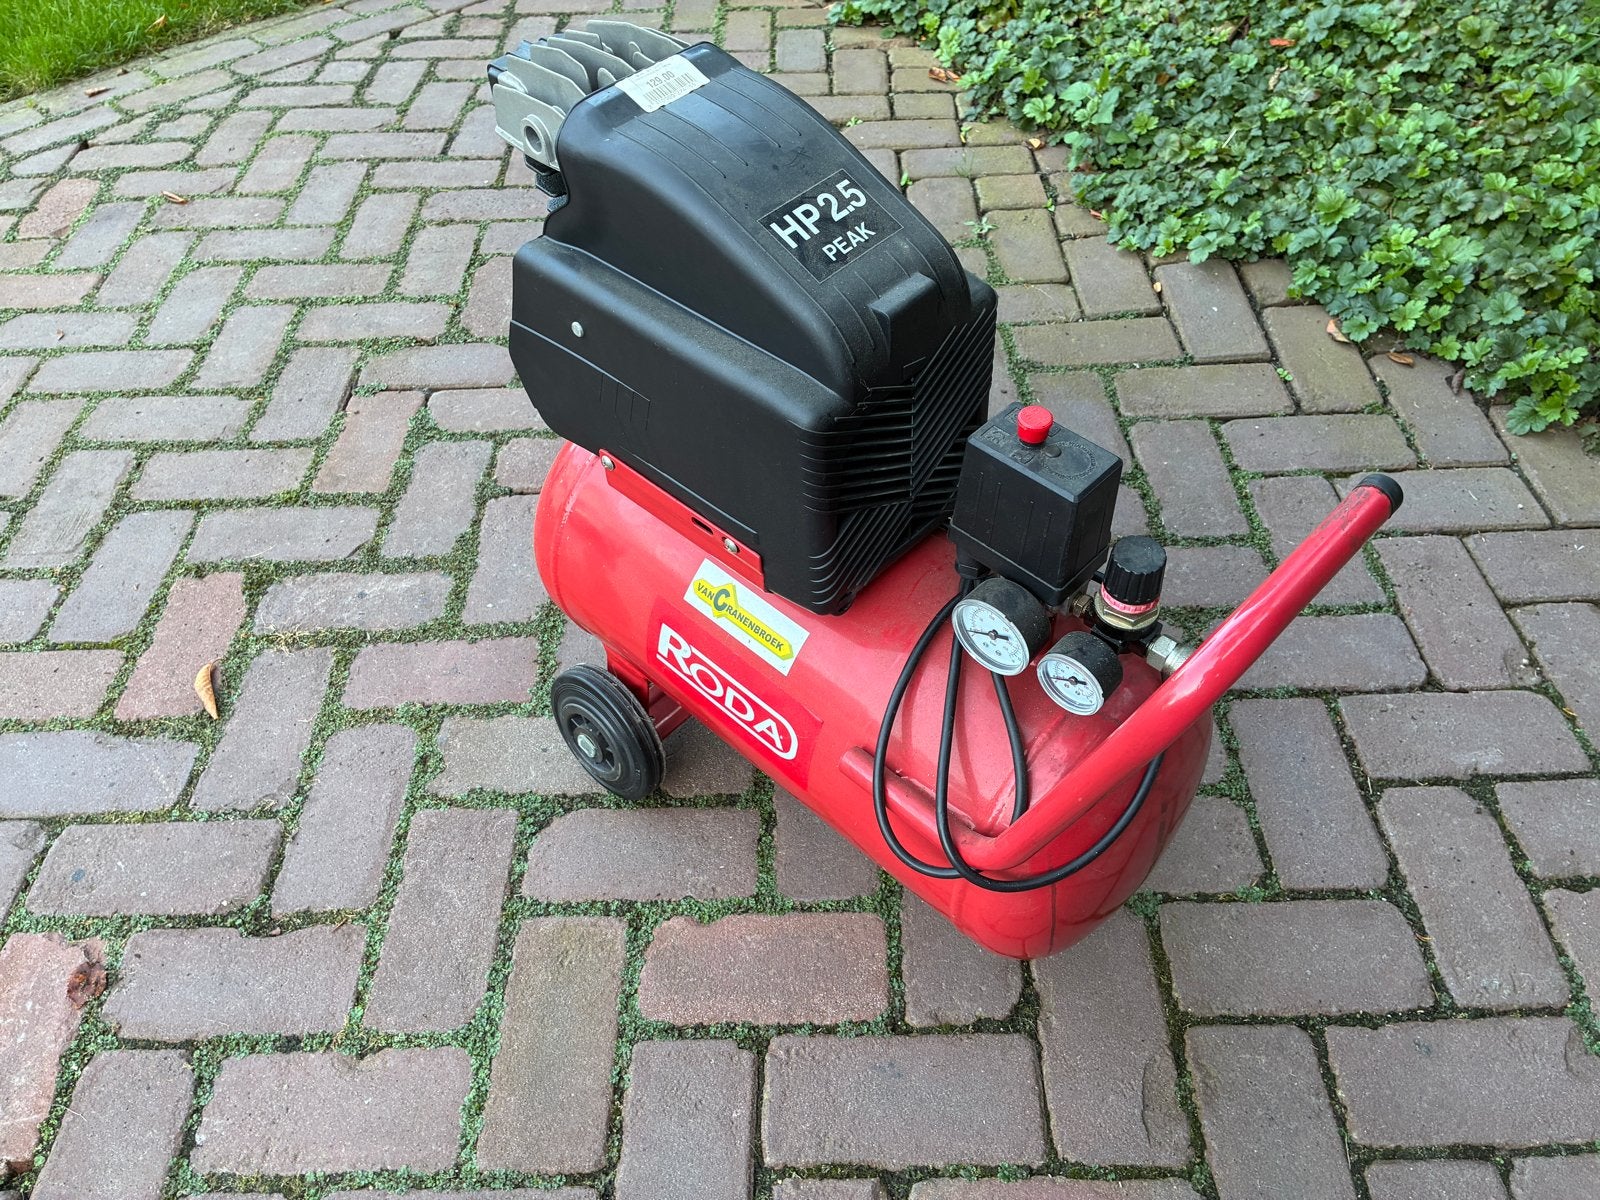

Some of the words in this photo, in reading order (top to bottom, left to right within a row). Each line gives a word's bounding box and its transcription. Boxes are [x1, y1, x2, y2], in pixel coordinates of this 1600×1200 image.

[821, 221, 876, 262] PEAK
[697, 582, 714, 601] VAN
[713, 588, 785, 652] CRANENBROEK
[657, 622, 784, 751] RODA
